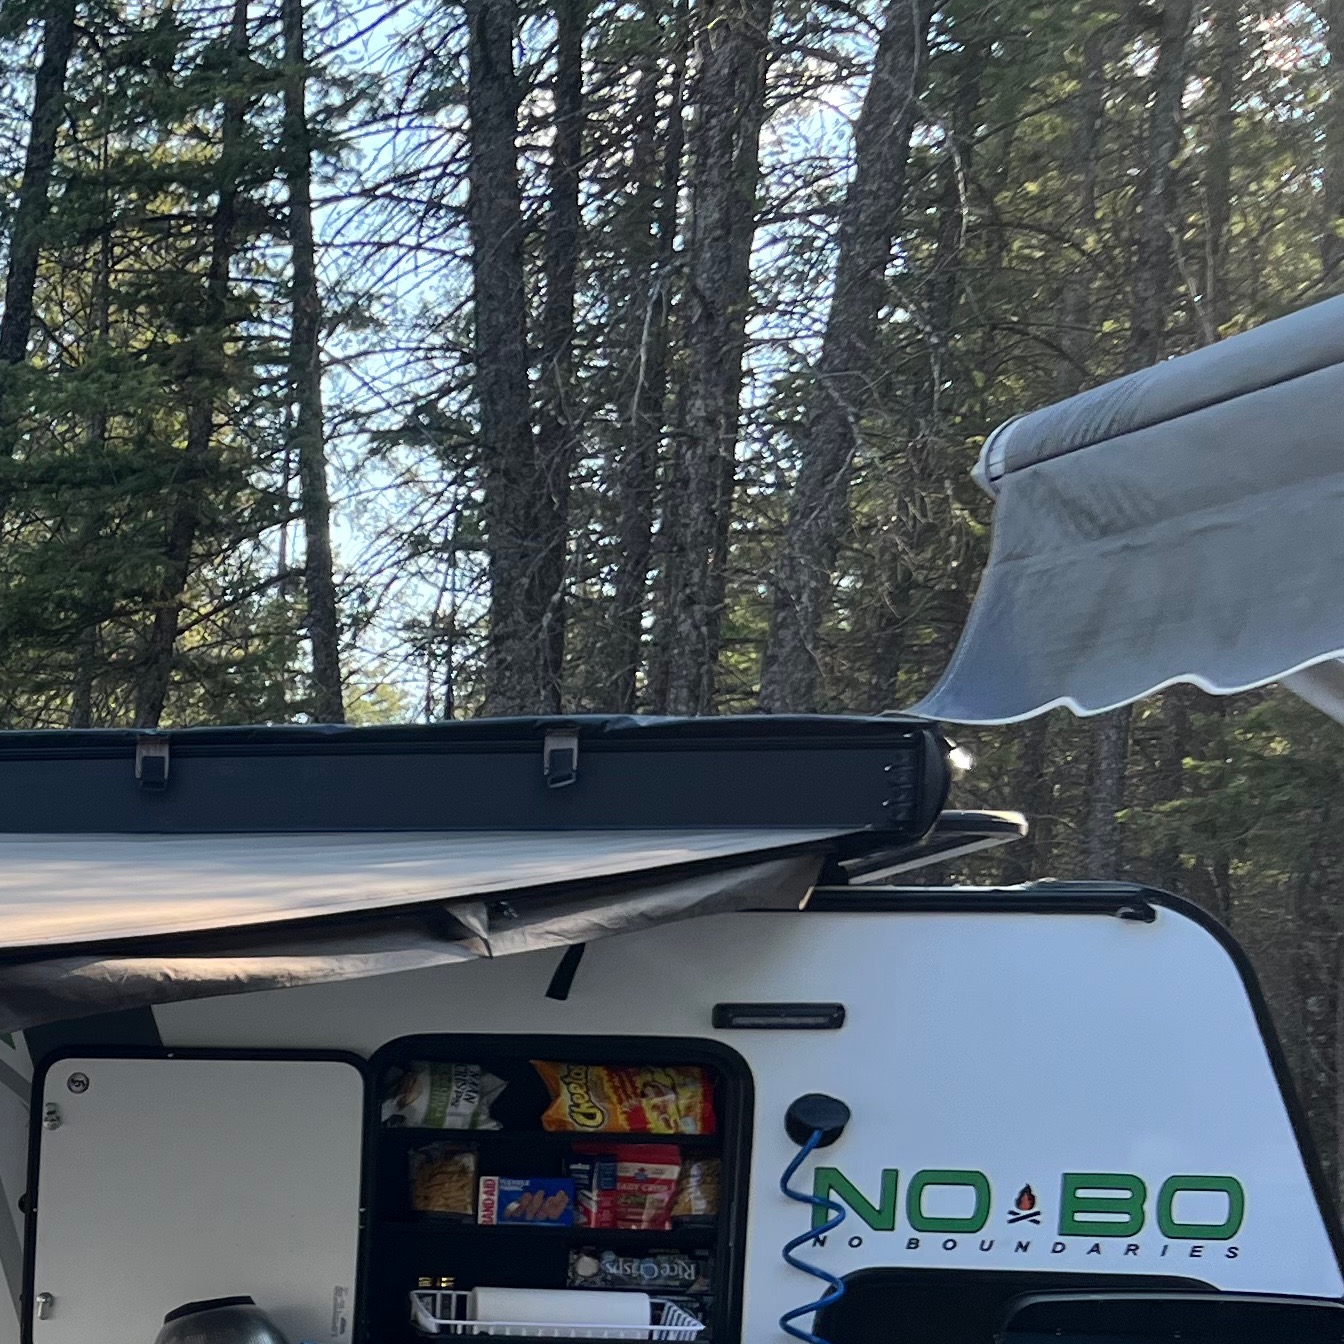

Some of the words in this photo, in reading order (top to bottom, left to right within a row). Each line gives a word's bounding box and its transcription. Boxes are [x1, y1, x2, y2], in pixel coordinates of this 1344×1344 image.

[561, 1065, 604, 1127] Cheeto
[814, 1167, 990, 1233] NO
[1058, 1173, 1245, 1240] BO
[812, 1235, 863, 1249] NO
[905, 1238, 1240, 1259] BOUNDARIES
[661, 1258, 696, 1280] Rice
